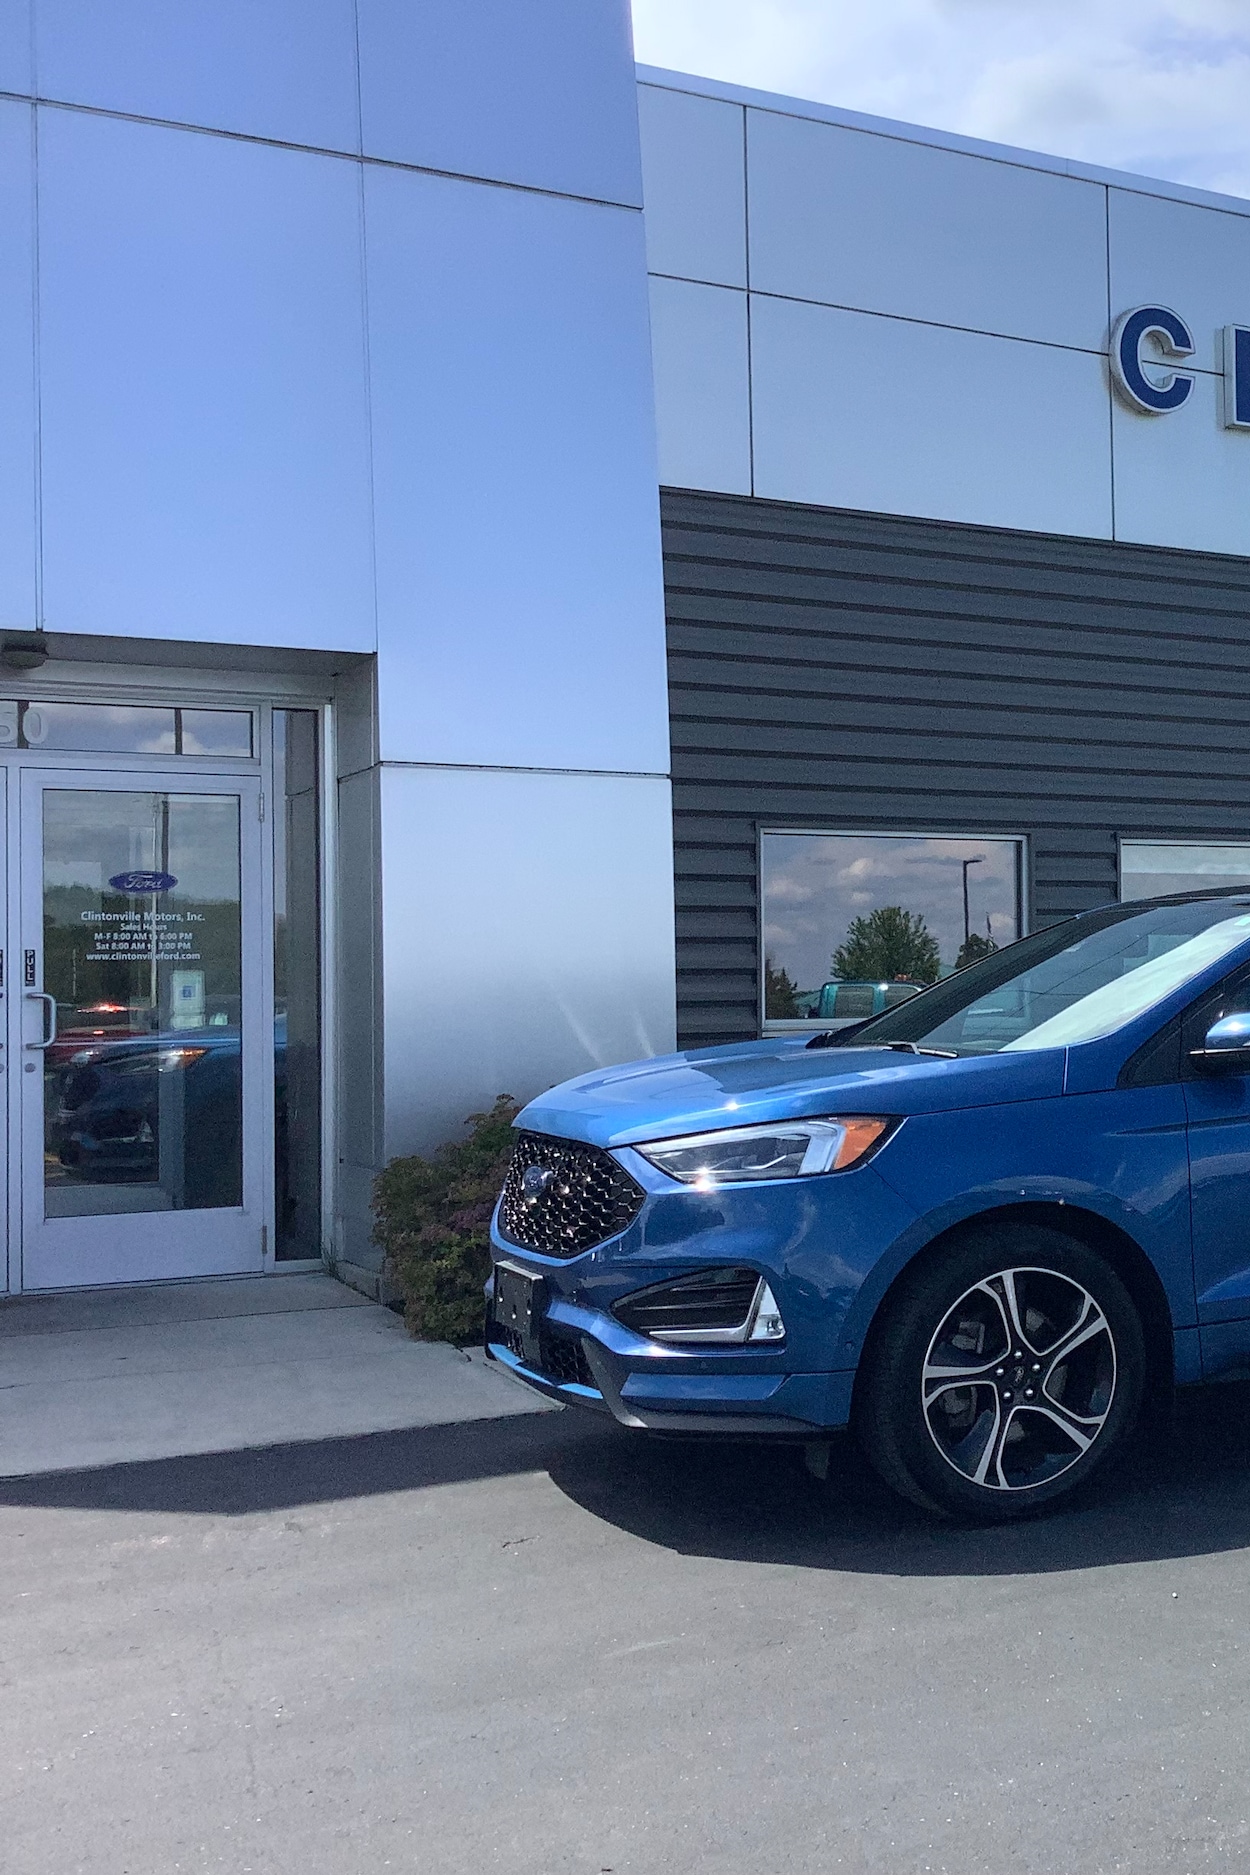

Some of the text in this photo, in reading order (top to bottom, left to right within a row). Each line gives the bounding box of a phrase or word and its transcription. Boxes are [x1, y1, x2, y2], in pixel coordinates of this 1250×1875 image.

[81, 911, 206, 922] Clintonville Motors, Inc.
[120, 923, 168, 931] Sales Hours
[94, 932, 111, 941] M-F
[113, 932, 131, 941] 8:00
[132, 932, 147, 941] AM
[149, 933, 158, 941] to
[179, 932, 193, 941] PM
[96, 942, 109, 951] Sat
[131, 942, 145, 951] AM
[147, 942, 157, 951] to
[177, 942, 191, 951] PM
[86, 952, 201, 961] www.clintonvilleford.com
[26, 950, 34, 981] PULL
